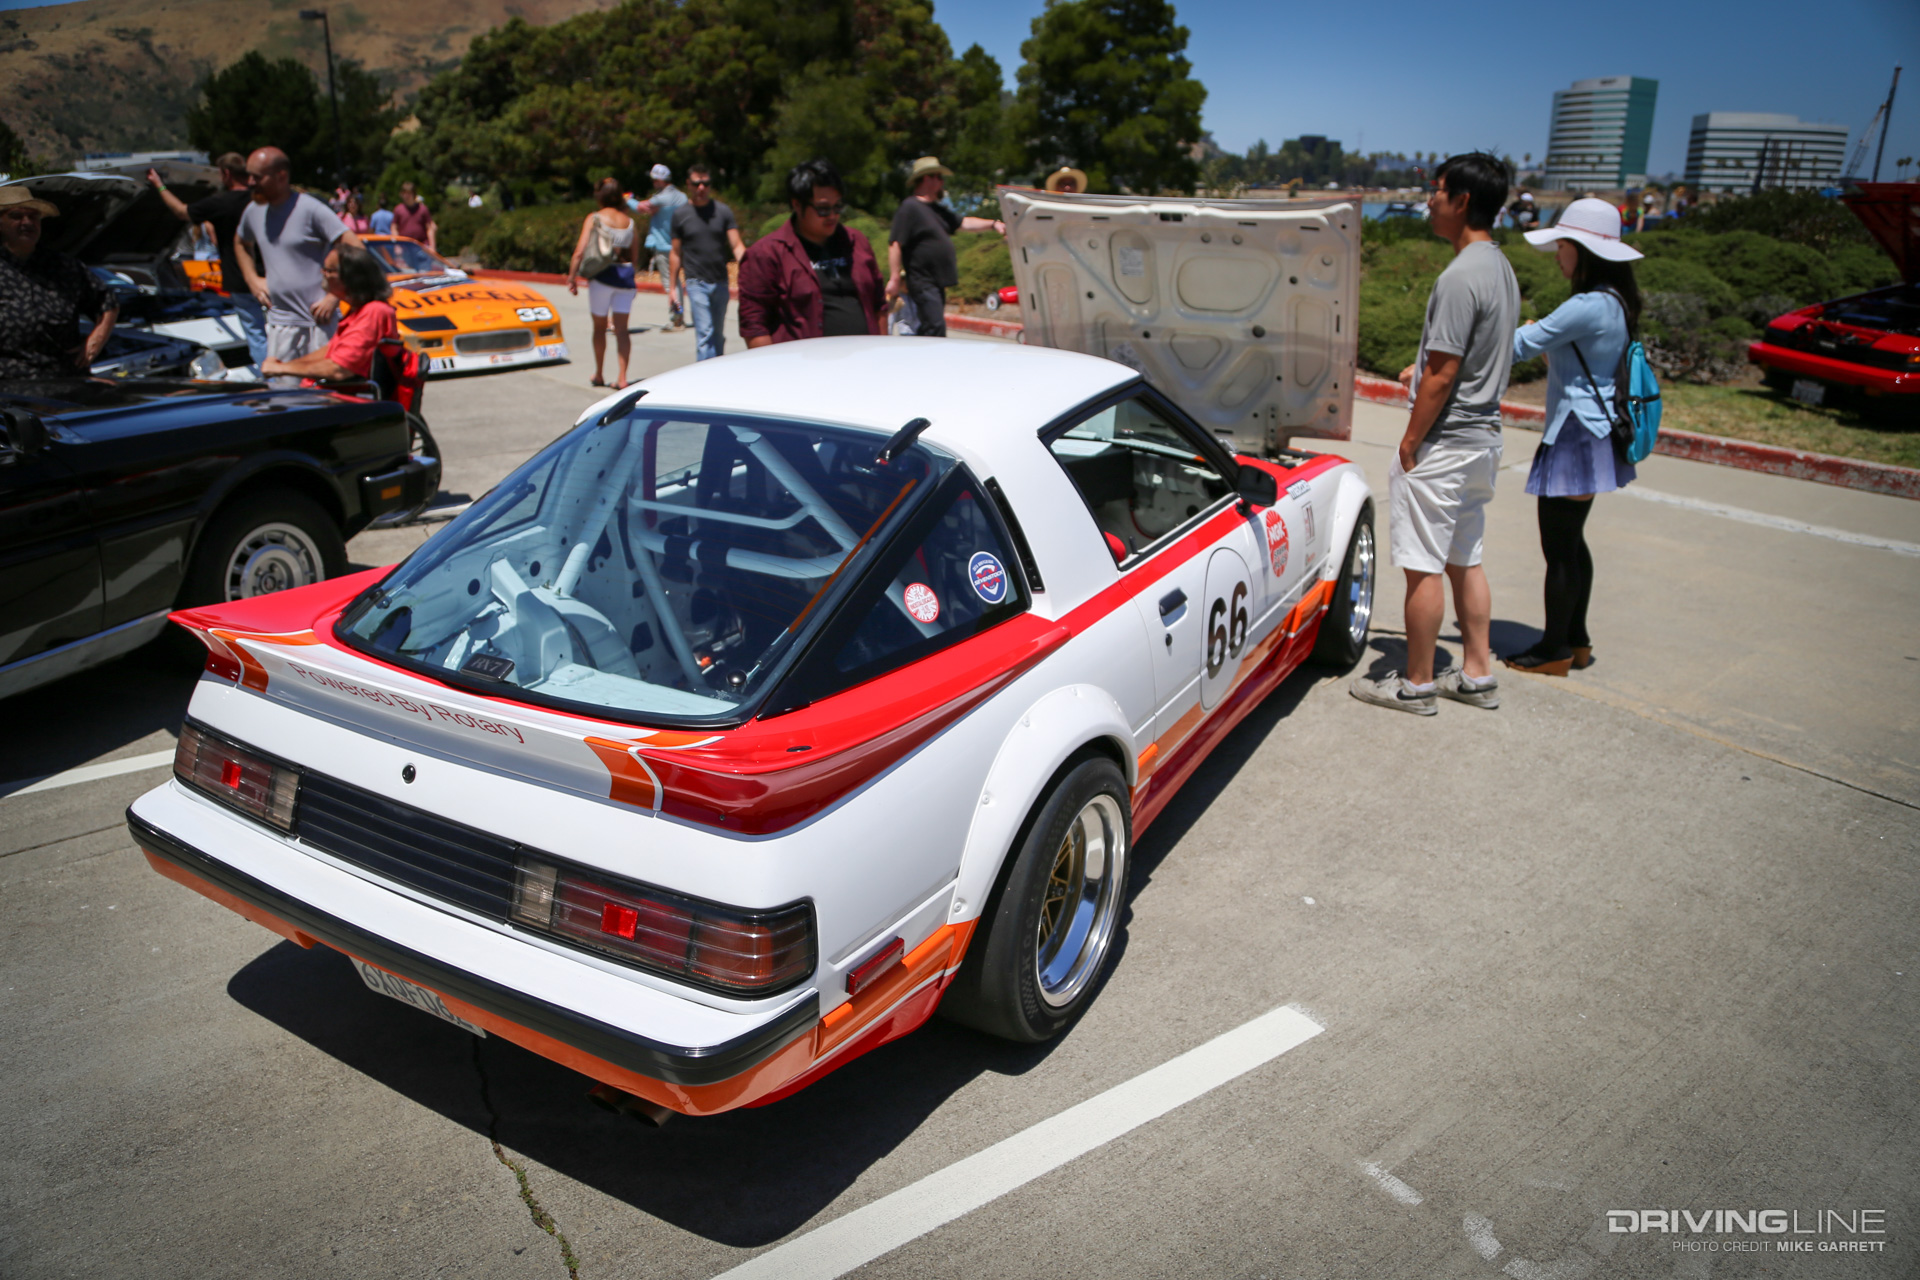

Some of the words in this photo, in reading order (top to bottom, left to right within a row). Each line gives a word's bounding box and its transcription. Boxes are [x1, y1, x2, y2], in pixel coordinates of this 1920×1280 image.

[393, 290, 548, 311] URACELL
[516, 306, 553, 322] 33
[1268, 520, 1286, 545] NGK
[1207, 581, 1248, 679] 66
[287, 662, 395, 707] Powered
[390, 693, 432, 721] By
[429, 704, 525, 744] Rotary
